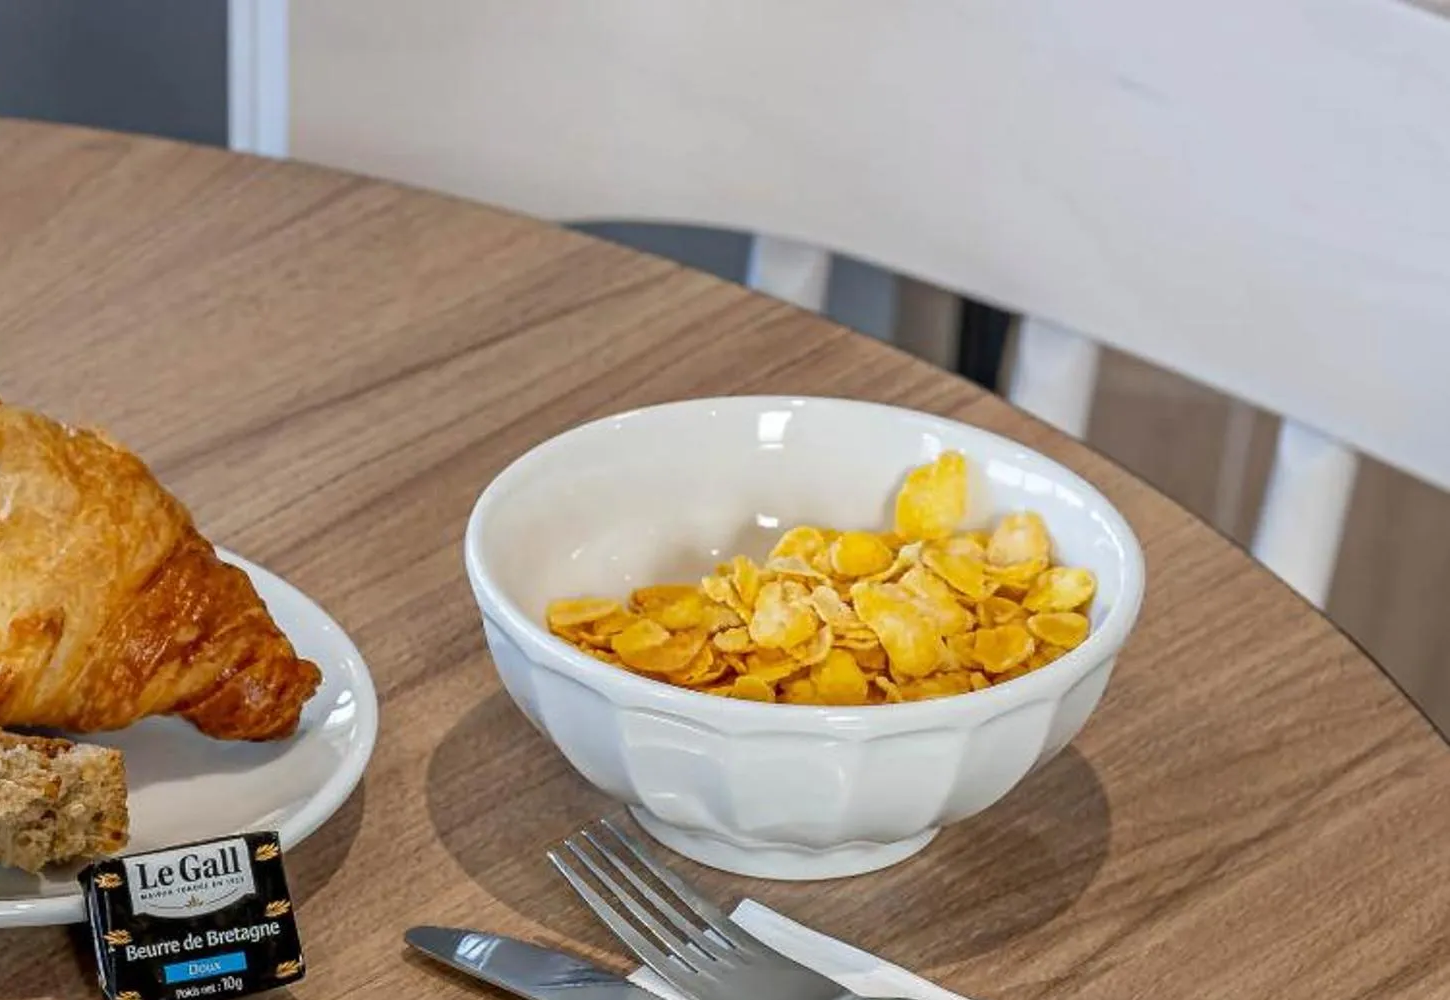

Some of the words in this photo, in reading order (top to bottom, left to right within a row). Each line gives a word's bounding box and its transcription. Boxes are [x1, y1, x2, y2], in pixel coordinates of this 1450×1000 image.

[135, 863, 174, 890] Le
[179, 846, 243, 882] Gall
[125, 938, 181, 962] Beurre
[183, 932, 204, 951] de
[206, 920, 281, 947] Bretagne
[188, 960, 222, 975] Doux
